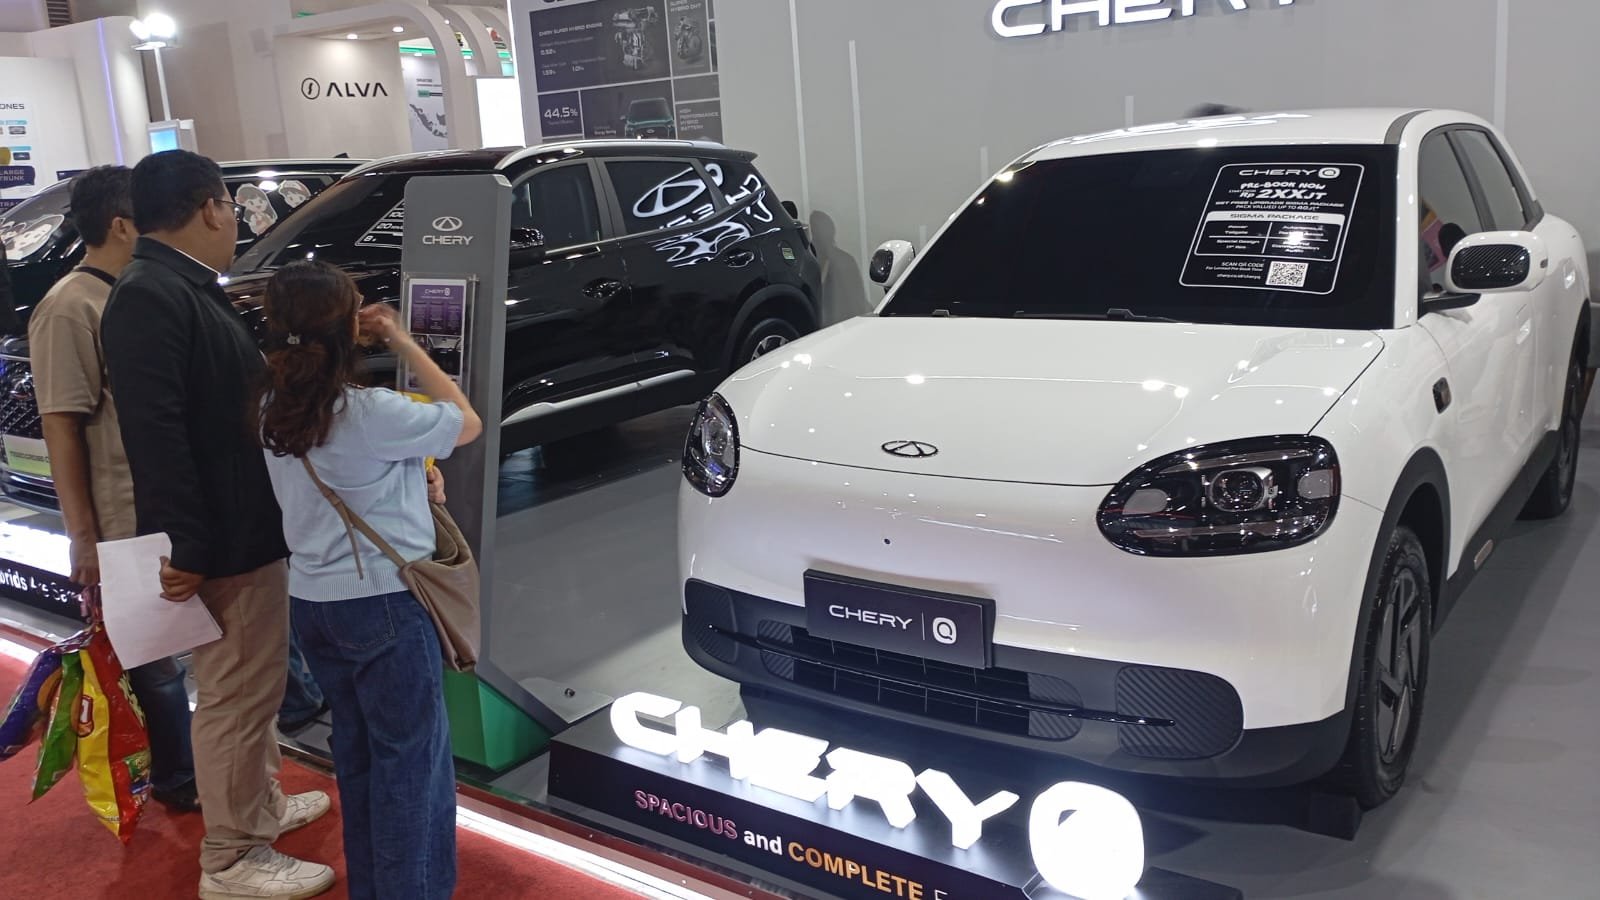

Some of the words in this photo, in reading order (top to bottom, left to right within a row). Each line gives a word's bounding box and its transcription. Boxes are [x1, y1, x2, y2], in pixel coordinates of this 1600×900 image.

[326, 82, 389, 97] ALVA
[543, 106, 579, 119] 44.5%
[1298, 182, 1326, 190] NOW
[422, 235, 474, 246] CHERY
[828, 604, 913, 630] CHERY
[610, 690, 1020, 851] CHERY
[633, 789, 738, 840] SPACIOUS
[743, 828, 783, 855] and
[788, 841, 924, 900] COMPLETE
